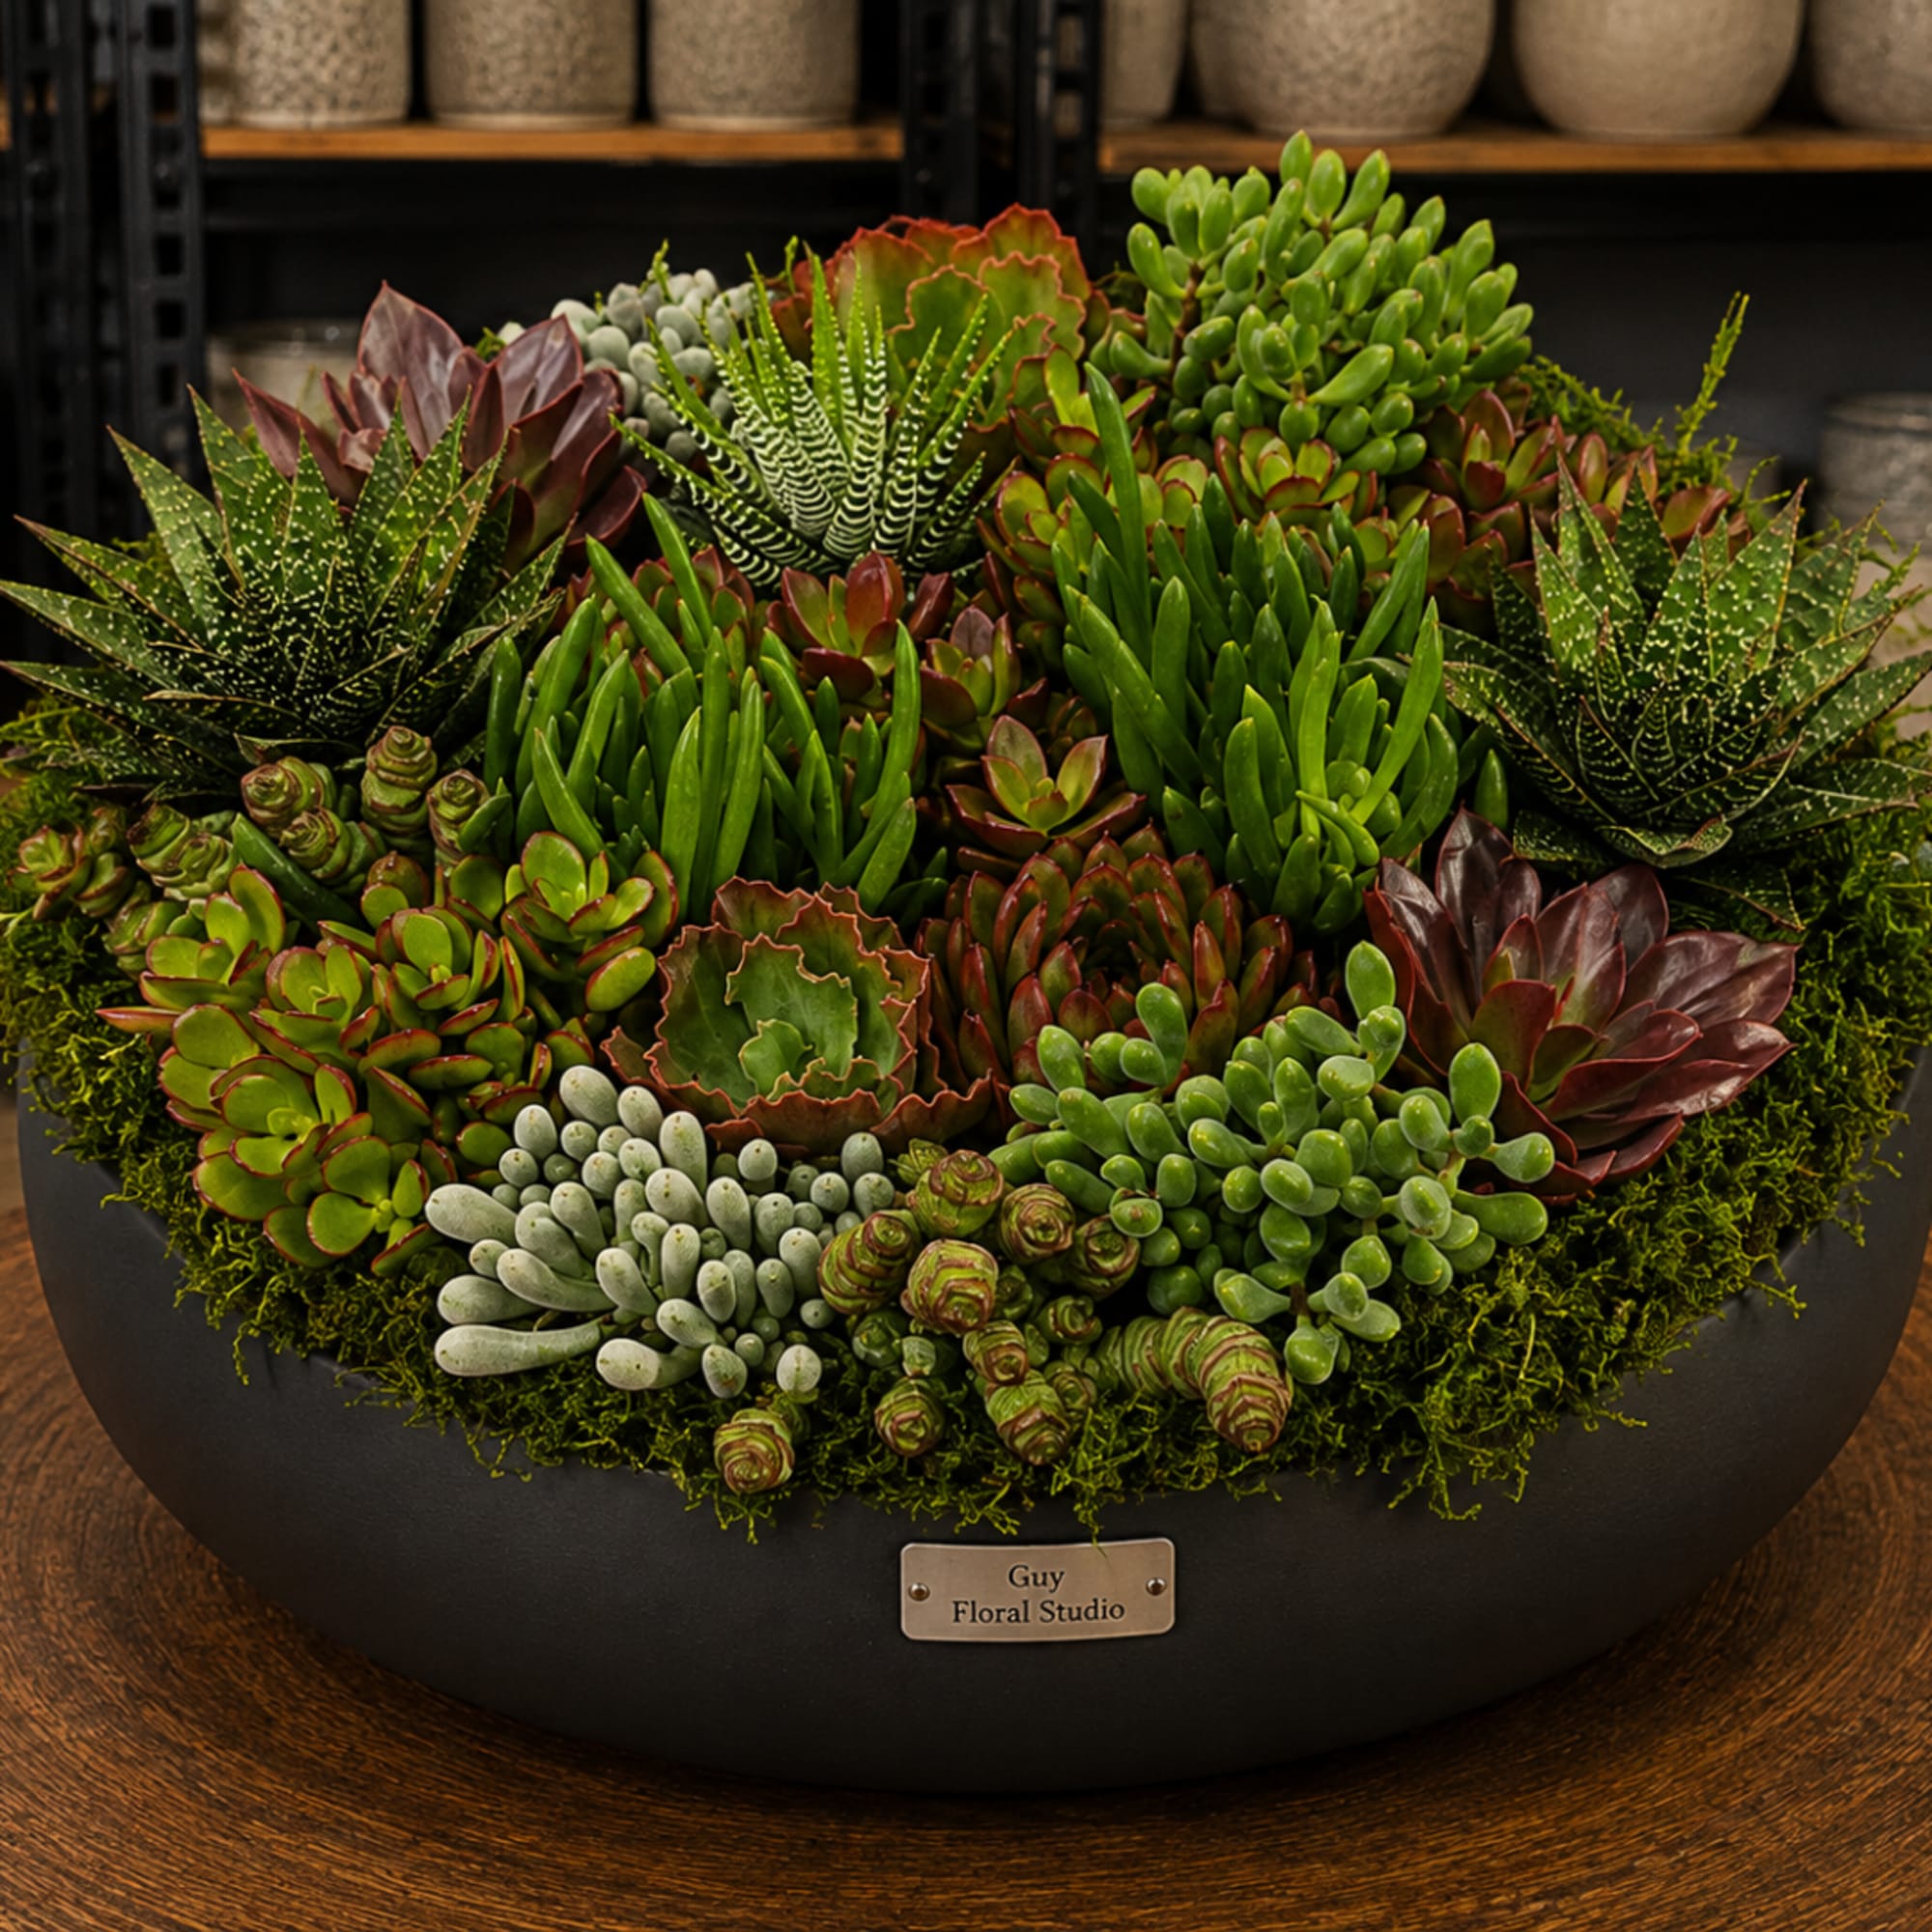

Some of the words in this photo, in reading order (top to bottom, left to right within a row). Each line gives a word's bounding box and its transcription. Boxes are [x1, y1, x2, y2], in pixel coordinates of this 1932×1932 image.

[1008, 1564, 1065, 1593] Guy
[952, 1600, 1031, 1624] Floral
[1038, 1598, 1125, 1623] Studio
